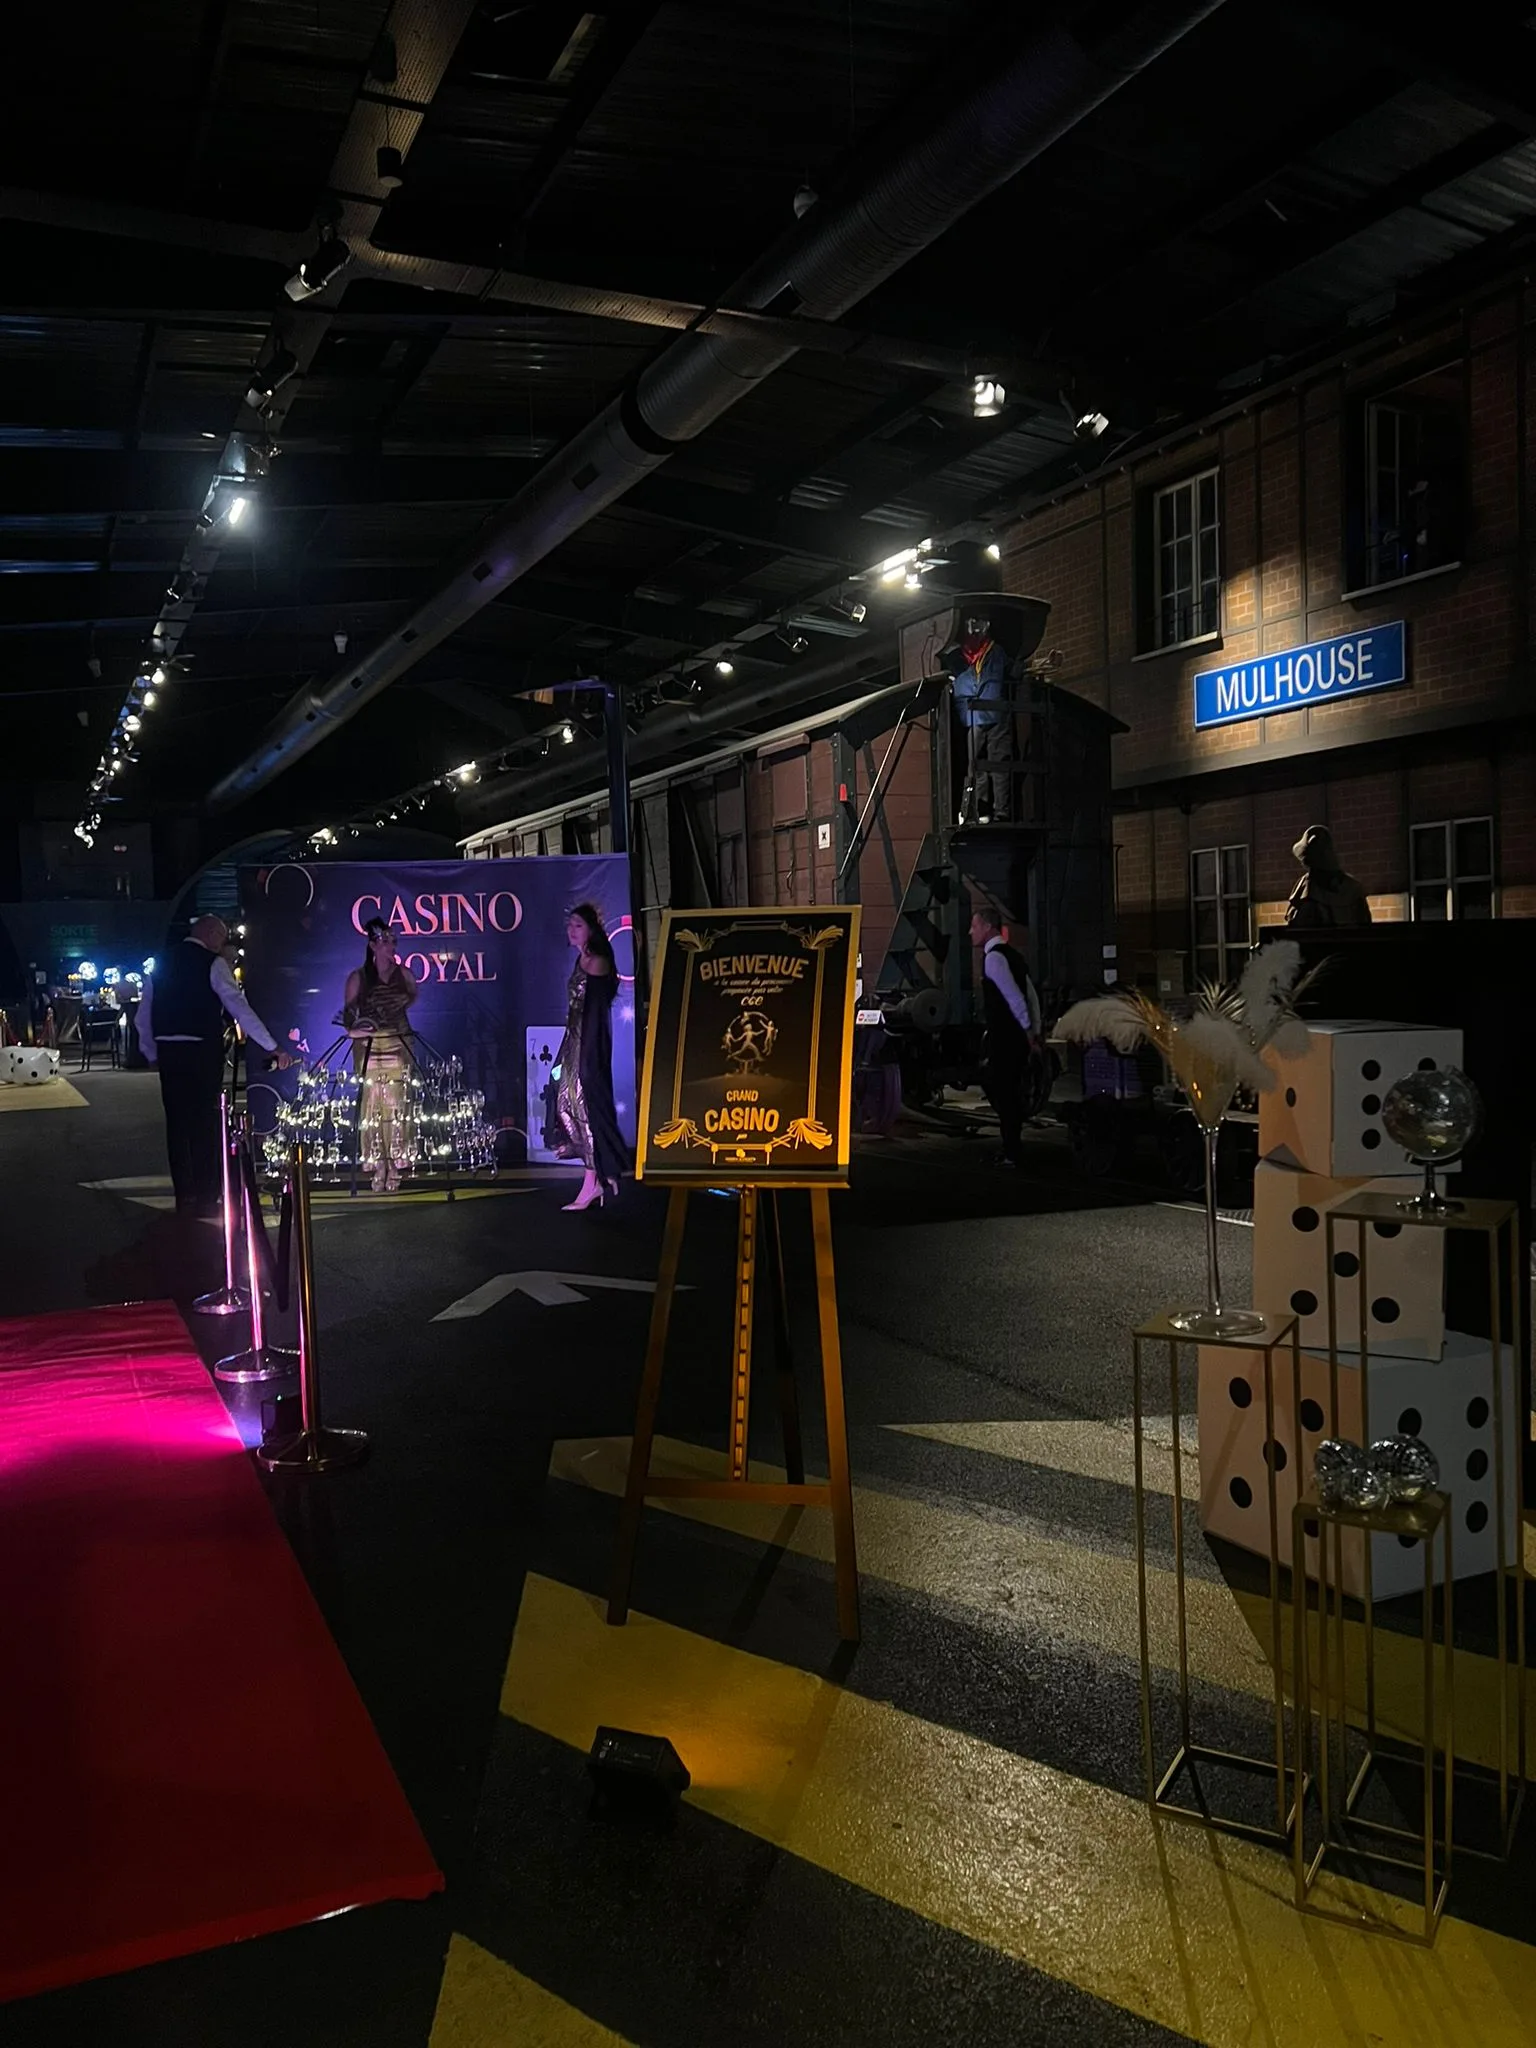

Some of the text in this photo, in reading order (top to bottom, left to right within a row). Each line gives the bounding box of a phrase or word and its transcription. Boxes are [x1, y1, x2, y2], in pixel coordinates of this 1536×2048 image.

[1216, 637, 1374, 714] MULHOUSE
[351, 890, 524, 936] CASINO
[50, 924, 98, 938] SORTIE
[393, 951, 497, 983] OYAL
[700, 954, 809, 981] BIENVENUE
[726, 1089, 759, 1102] GRAND
[704, 1107, 780, 1132] CASINO
